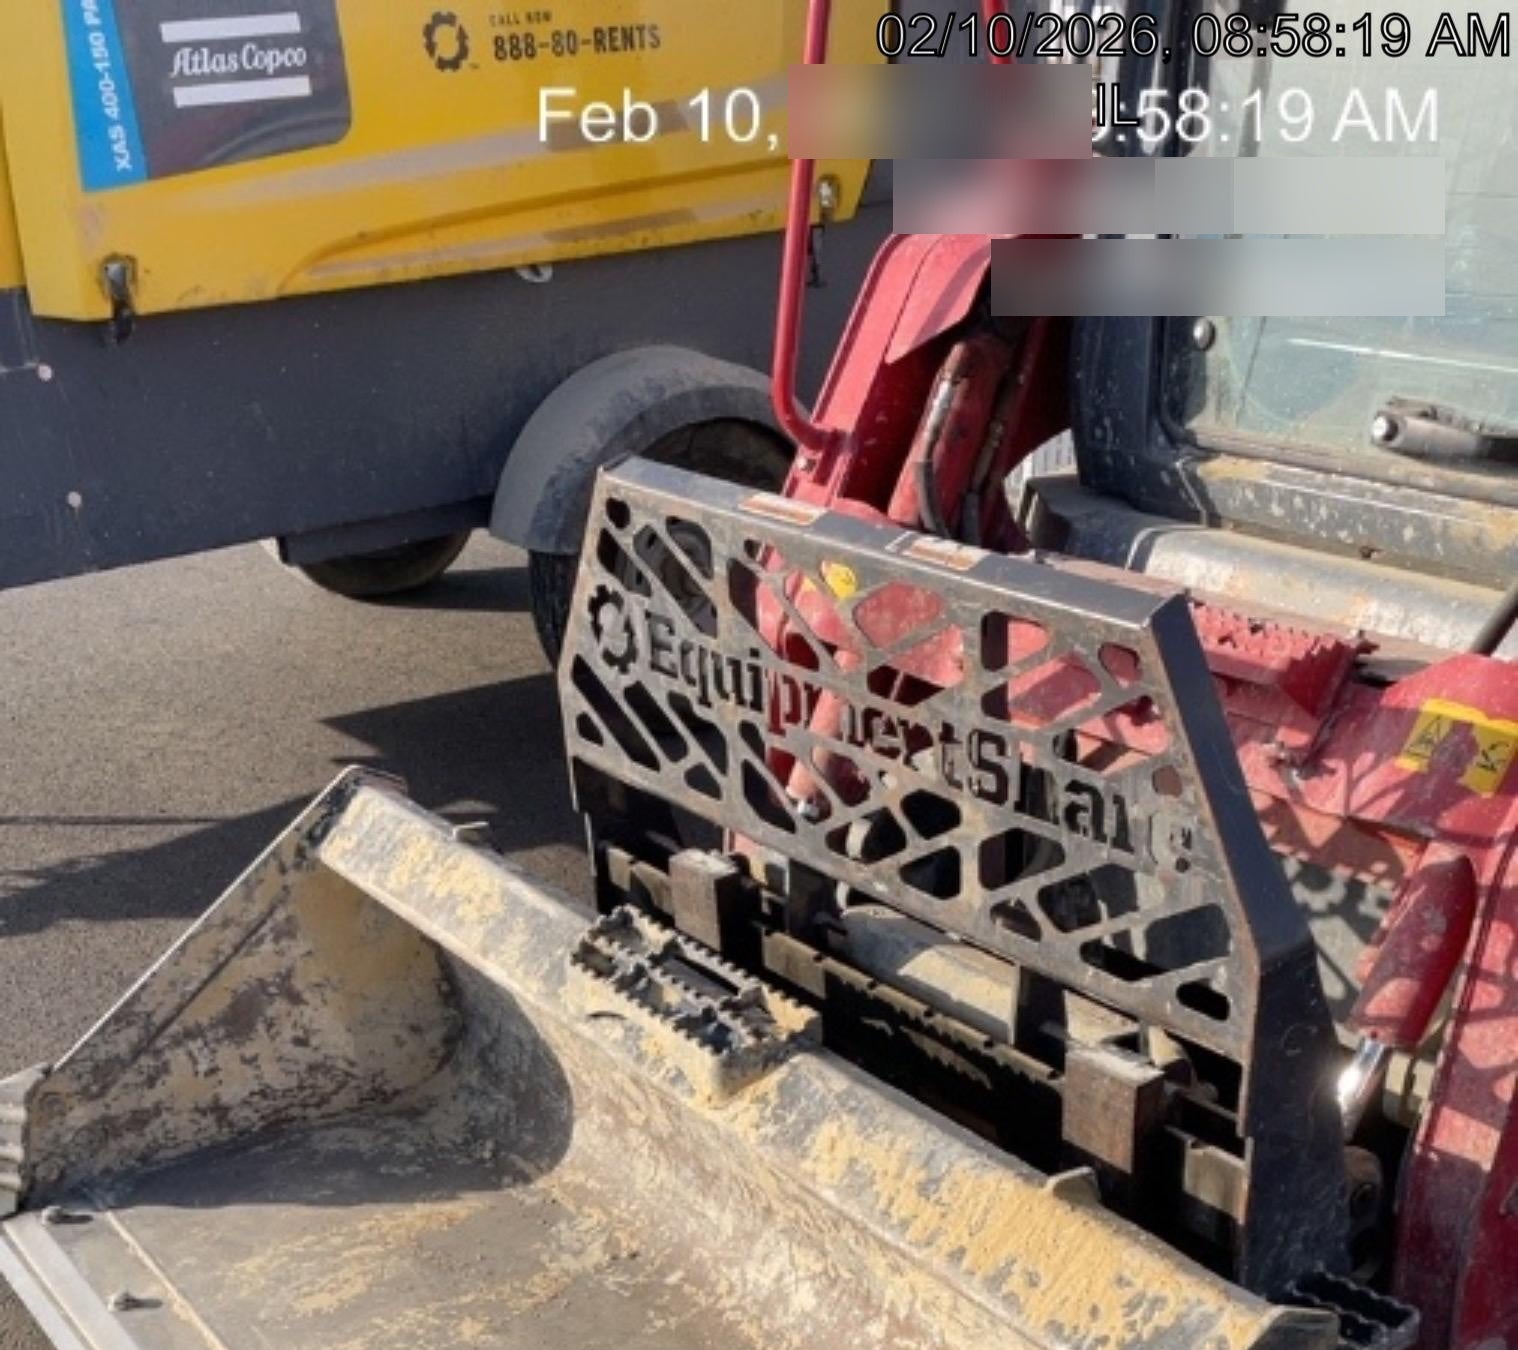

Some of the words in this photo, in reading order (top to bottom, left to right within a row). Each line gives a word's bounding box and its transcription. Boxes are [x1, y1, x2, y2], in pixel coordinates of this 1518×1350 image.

[170, 47, 239, 78] Atlas
[241, 42, 307, 75] Copco
[494, 24, 661, 61] 888-80-RENTS
[107, 125, 133, 172] XAS
